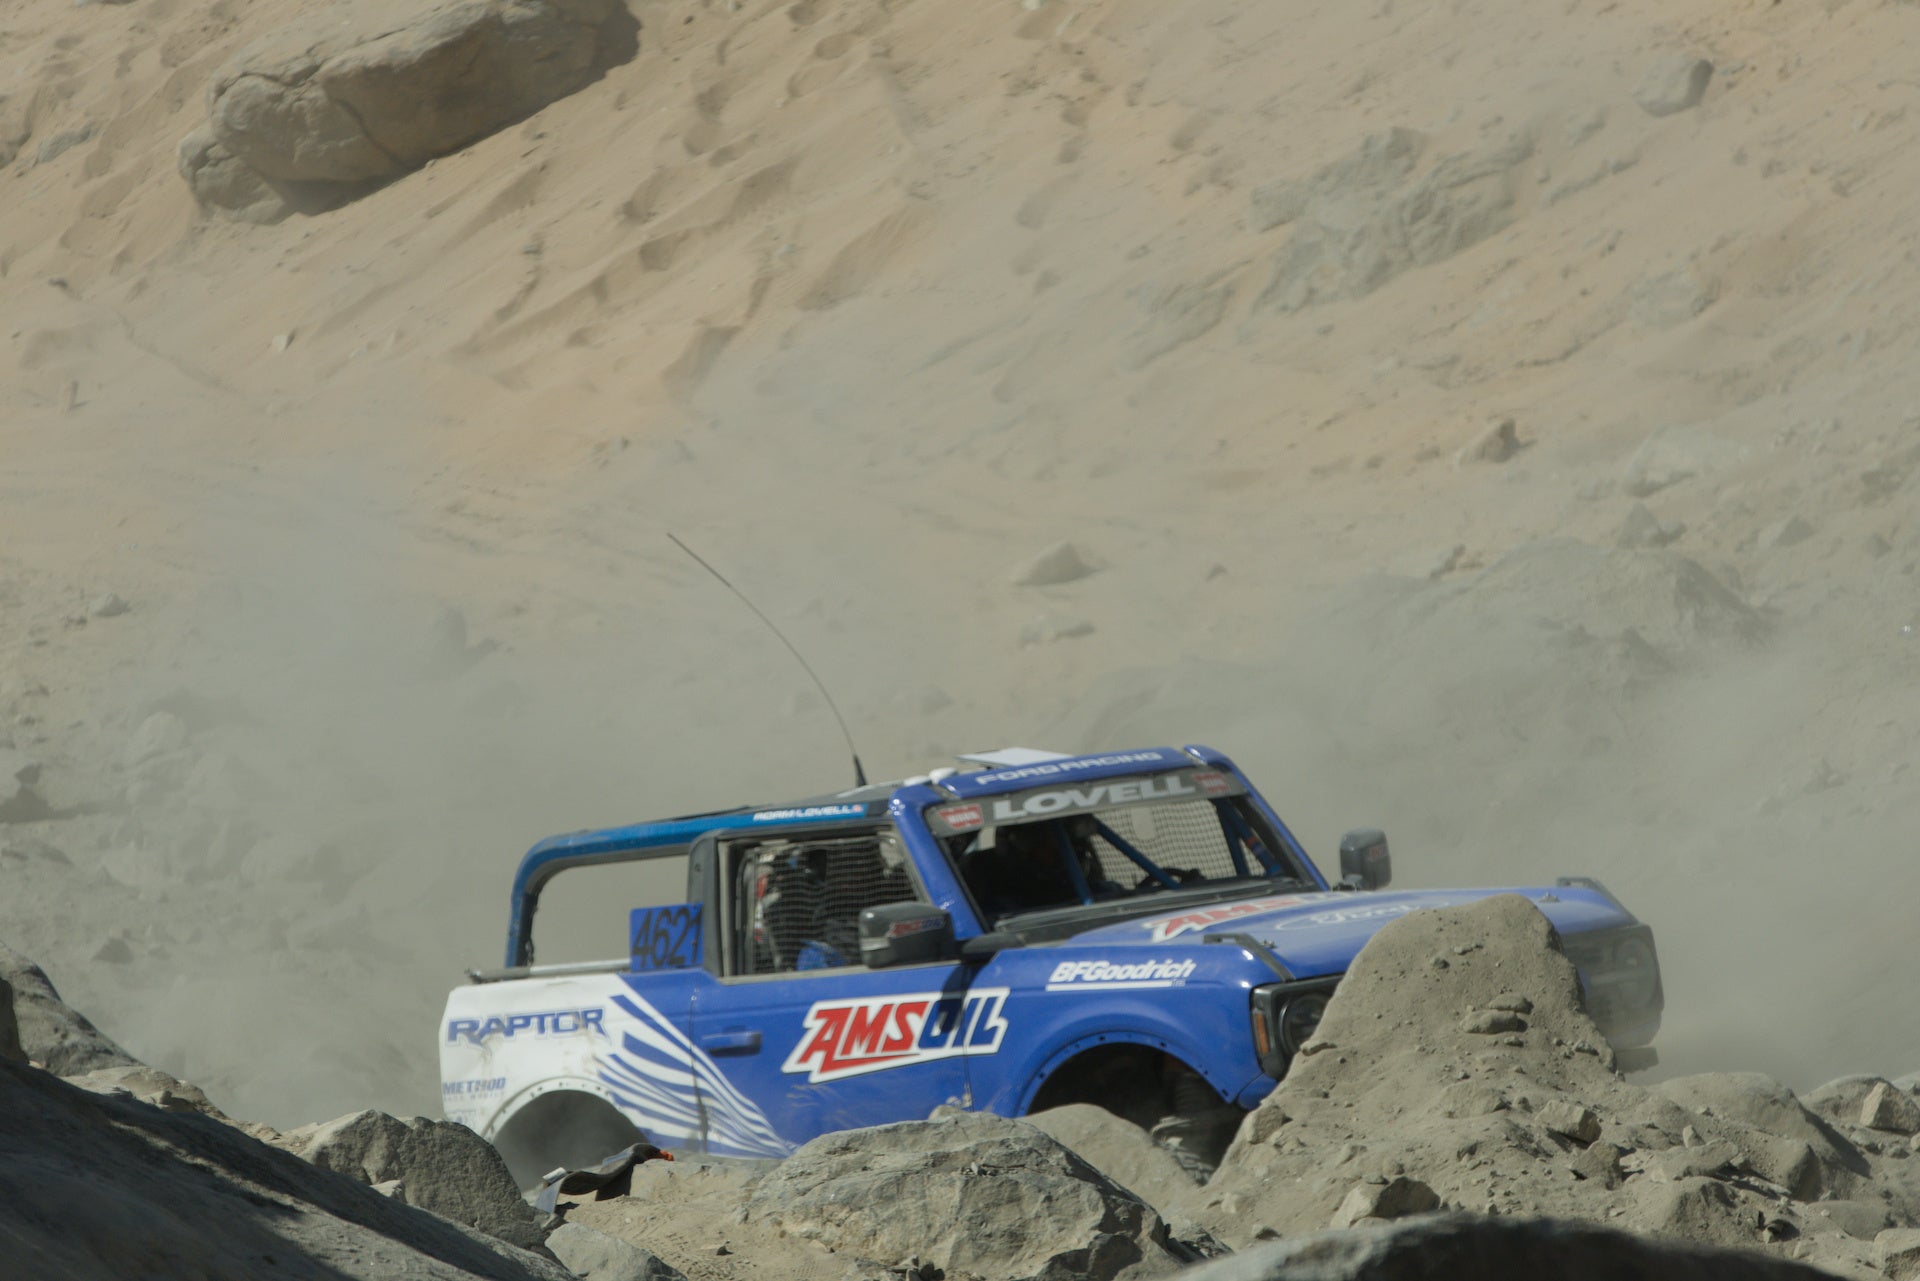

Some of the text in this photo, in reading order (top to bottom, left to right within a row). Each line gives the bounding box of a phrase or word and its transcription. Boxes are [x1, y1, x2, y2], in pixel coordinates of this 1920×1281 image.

[976, 764, 1061, 785] FORD
[796, 805, 851, 818] LOVELL
[993, 776, 1196, 820] LOVELL
[632, 906, 702, 968] 4621
[1049, 958, 1197, 983] BFGoodrich
[447, 1008, 609, 1046] RAPTOR
[789, 990, 1006, 1080] AMSOIL
